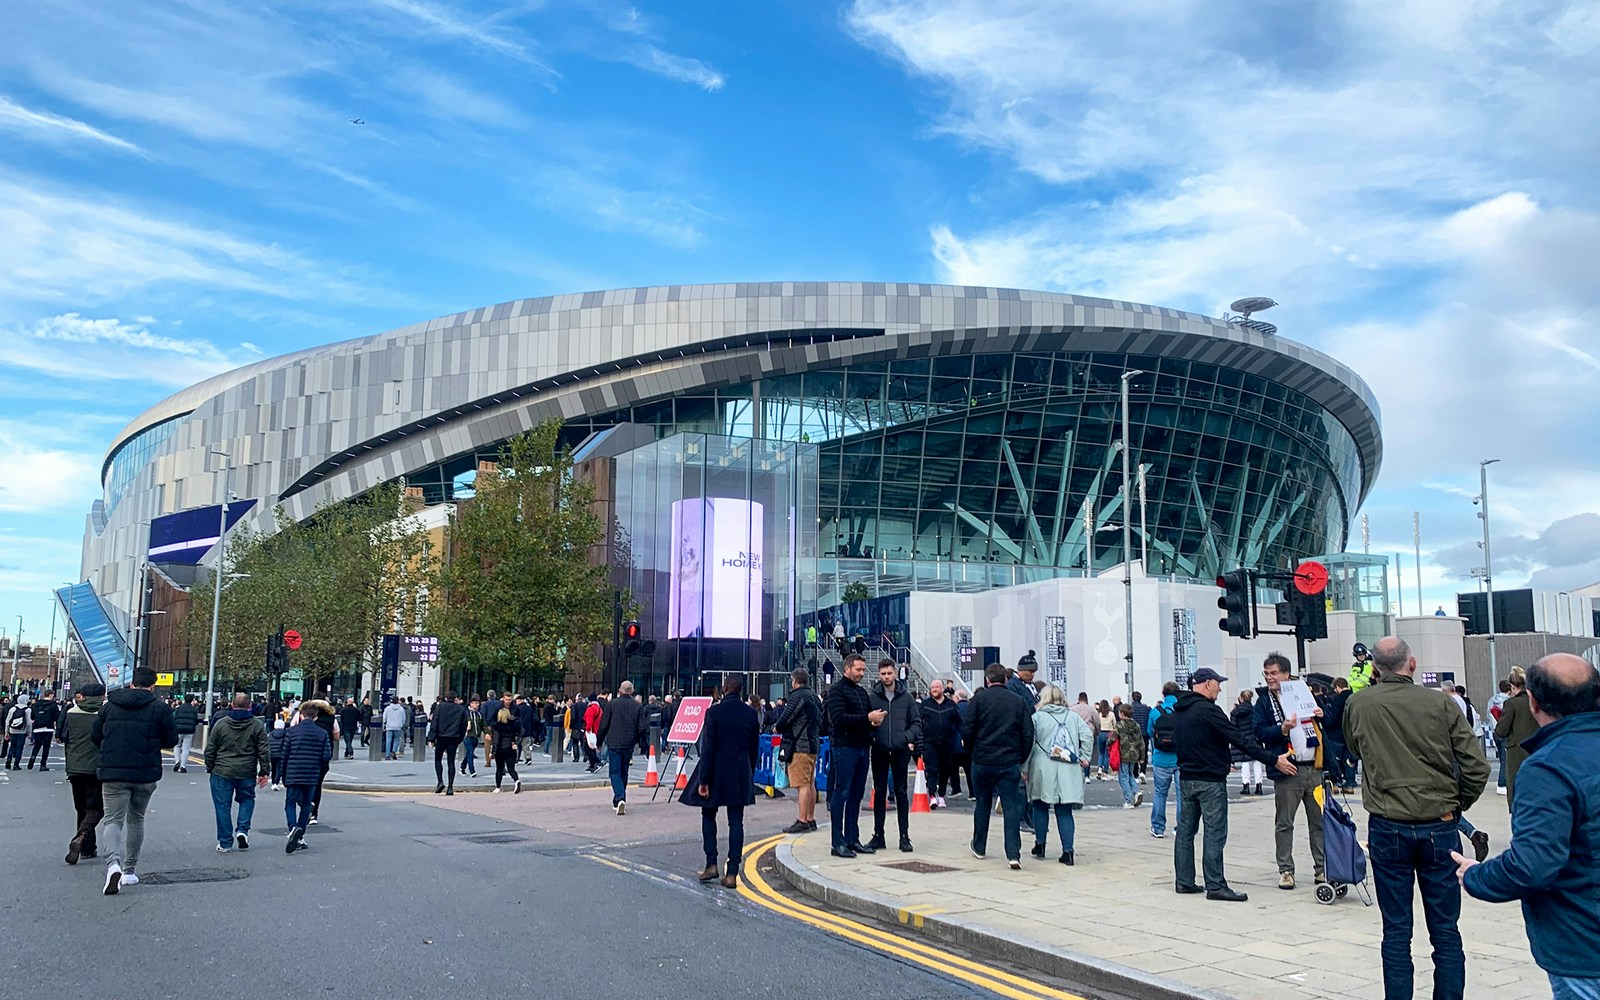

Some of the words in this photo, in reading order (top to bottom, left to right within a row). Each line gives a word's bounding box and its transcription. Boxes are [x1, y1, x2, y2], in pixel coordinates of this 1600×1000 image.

[739, 551, 760, 561] NEW
[684, 706, 702, 716] ROAD
[675, 722, 698, 733] CLOSED
